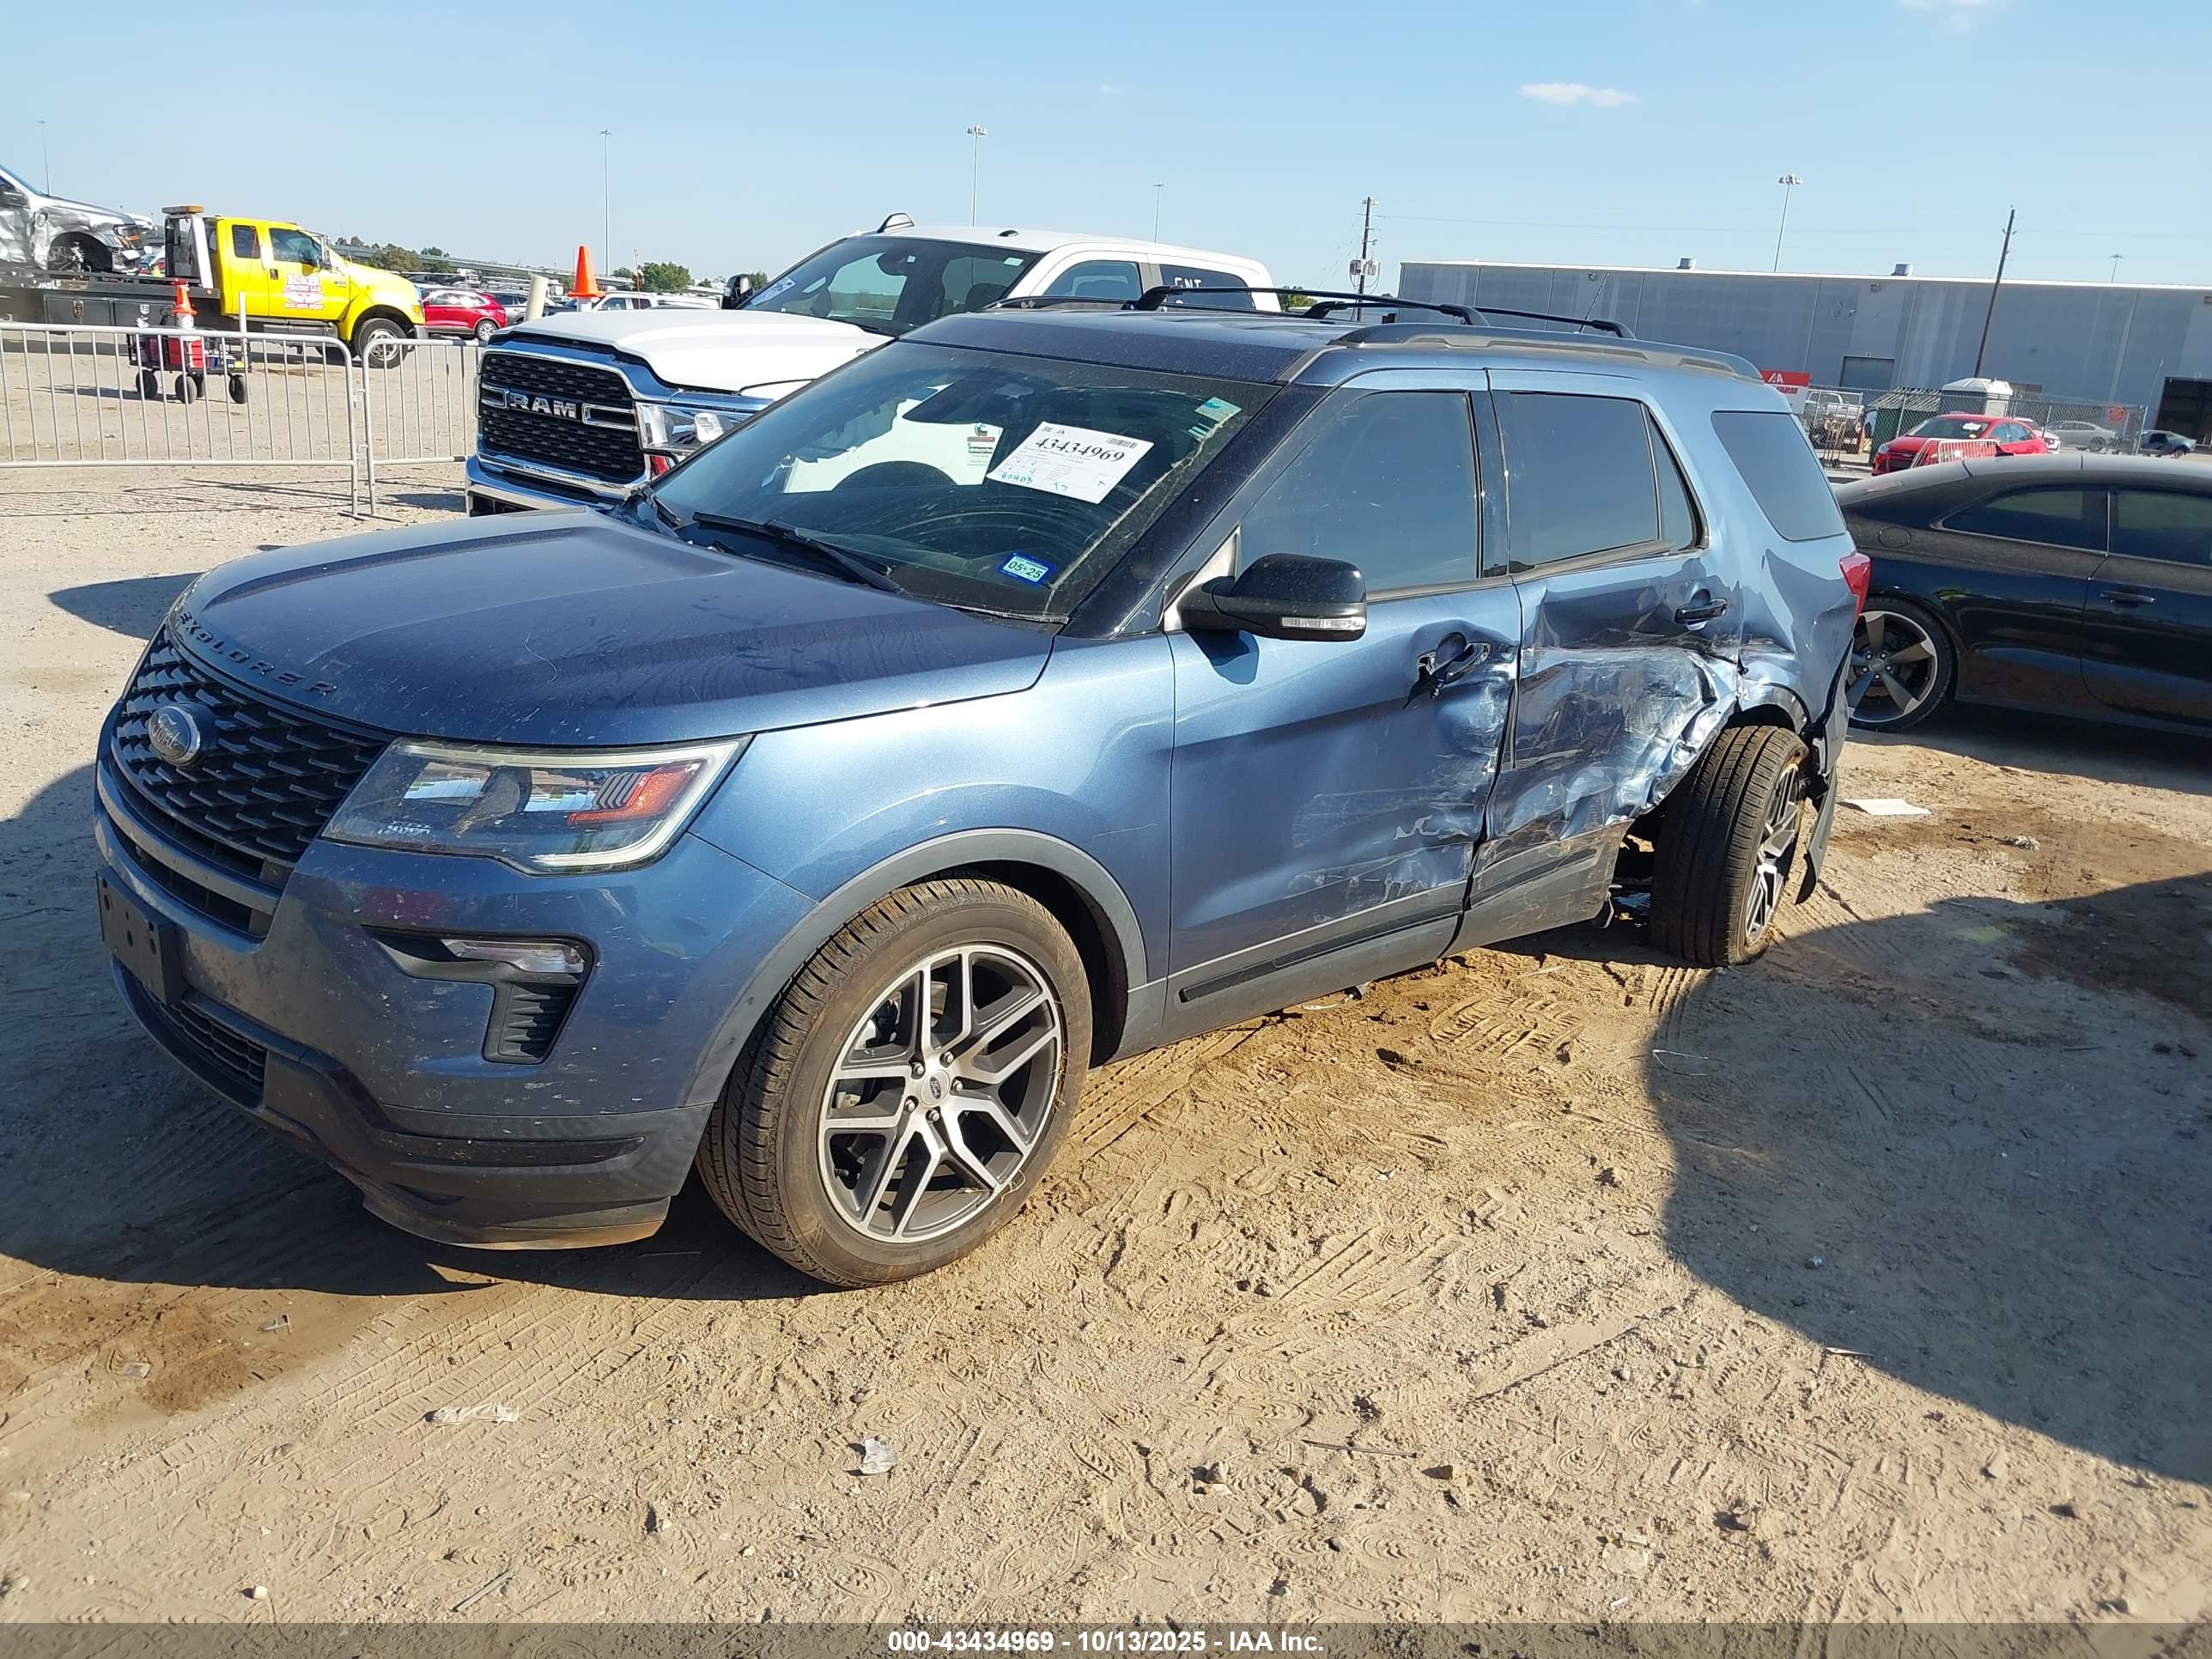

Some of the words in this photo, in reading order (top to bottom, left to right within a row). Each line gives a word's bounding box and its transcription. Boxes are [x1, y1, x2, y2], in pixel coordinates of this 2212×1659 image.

[509, 392, 577, 420] RAM
[1035, 437, 1126, 462] 43434969
[179, 611, 338, 697] EXPLORER
[150, 714, 181, 749] Ford
